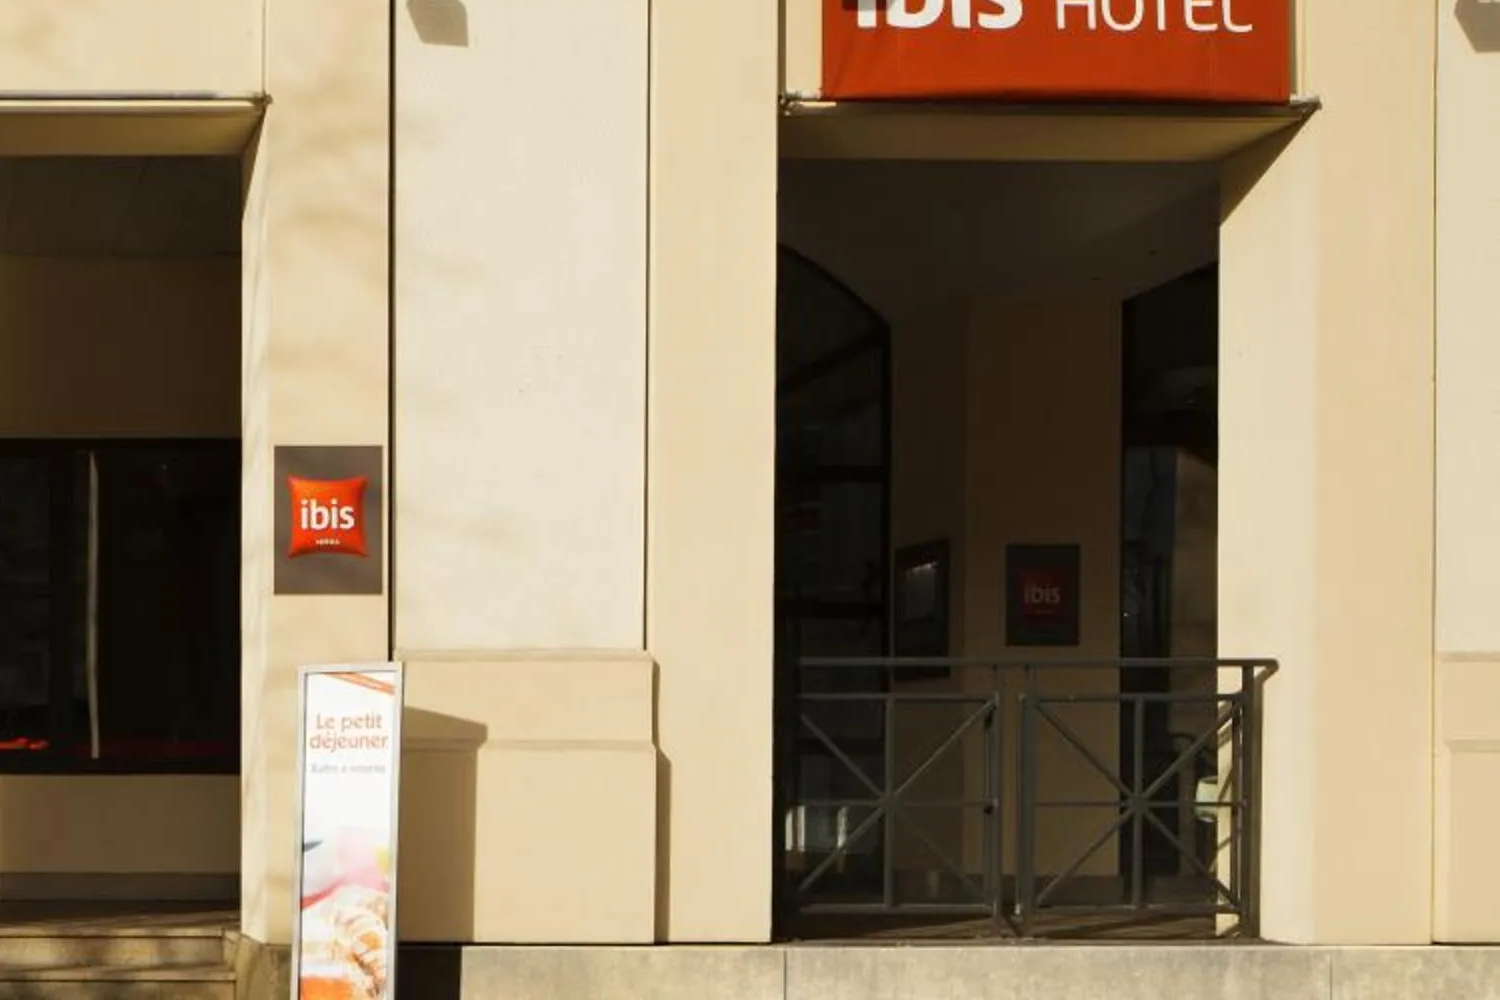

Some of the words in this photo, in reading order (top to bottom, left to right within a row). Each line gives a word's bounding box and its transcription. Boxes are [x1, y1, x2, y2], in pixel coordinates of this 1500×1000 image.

[300, 498, 355, 531] ibis
[1024, 582, 1061, 605] ibis
[316, 712, 336, 730] Le
[341, 712, 382, 733] petit
